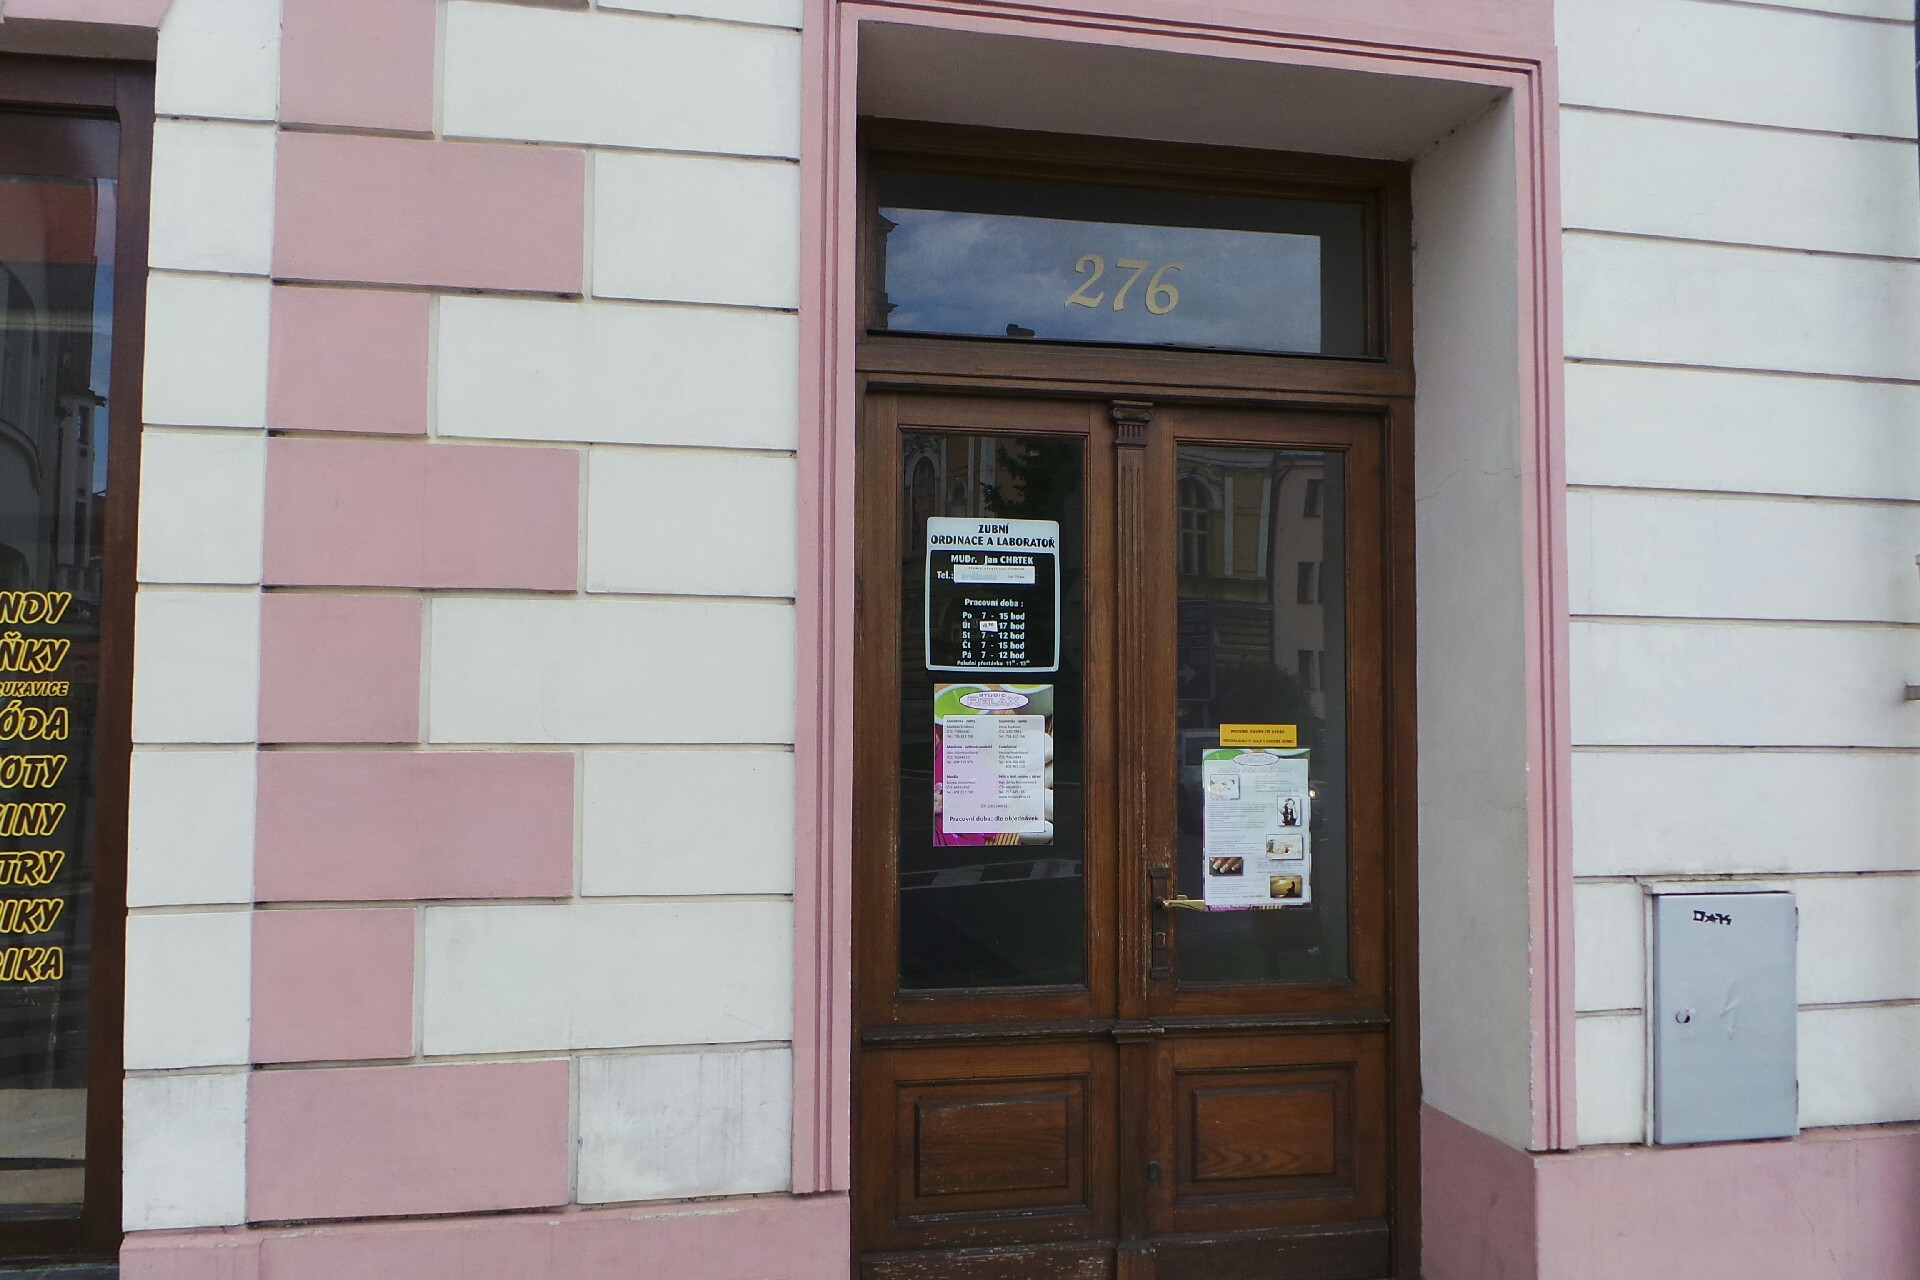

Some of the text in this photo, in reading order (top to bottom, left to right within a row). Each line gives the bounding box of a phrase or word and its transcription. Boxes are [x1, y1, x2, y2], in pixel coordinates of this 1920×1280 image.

[1064, 254, 1187, 316] 276
[978, 523, 1010, 534] ZUBNÍ
[931, 535, 1056, 548] ORDINACE A LABORATOŘ
[950, 554, 1034, 565] MUDr. Jan CHRTEK
[964, 598, 999, 607] Pracovní
[962, 612, 973, 620] Po
[981, 612, 987, 620] 7
[999, 612, 1009, 620] 15
[1010, 612, 1026, 620] hod
[962, 621, 971, 629] Út
[999, 622, 1008, 630] 17
[1010, 622, 1025, 630] hod
[1010, 631, 1025, 639] hod
[962, 640, 971, 649] Čt
[1010, 641, 1025, 649] hod
[962, 651, 972, 659] Pá
[981, 651, 987, 659] 7
[998, 651, 1009, 659] 12
[1010, 651, 1025, 659] hod
[0, 680, 69, 697] UKAVICE
[967, 697, 1021, 706] RELAX
[0, 754, 67, 788] OTY
[0, 802, 66, 836] INY
[0, 898, 64, 934] IKY
[0, 947, 63, 983] IKA
